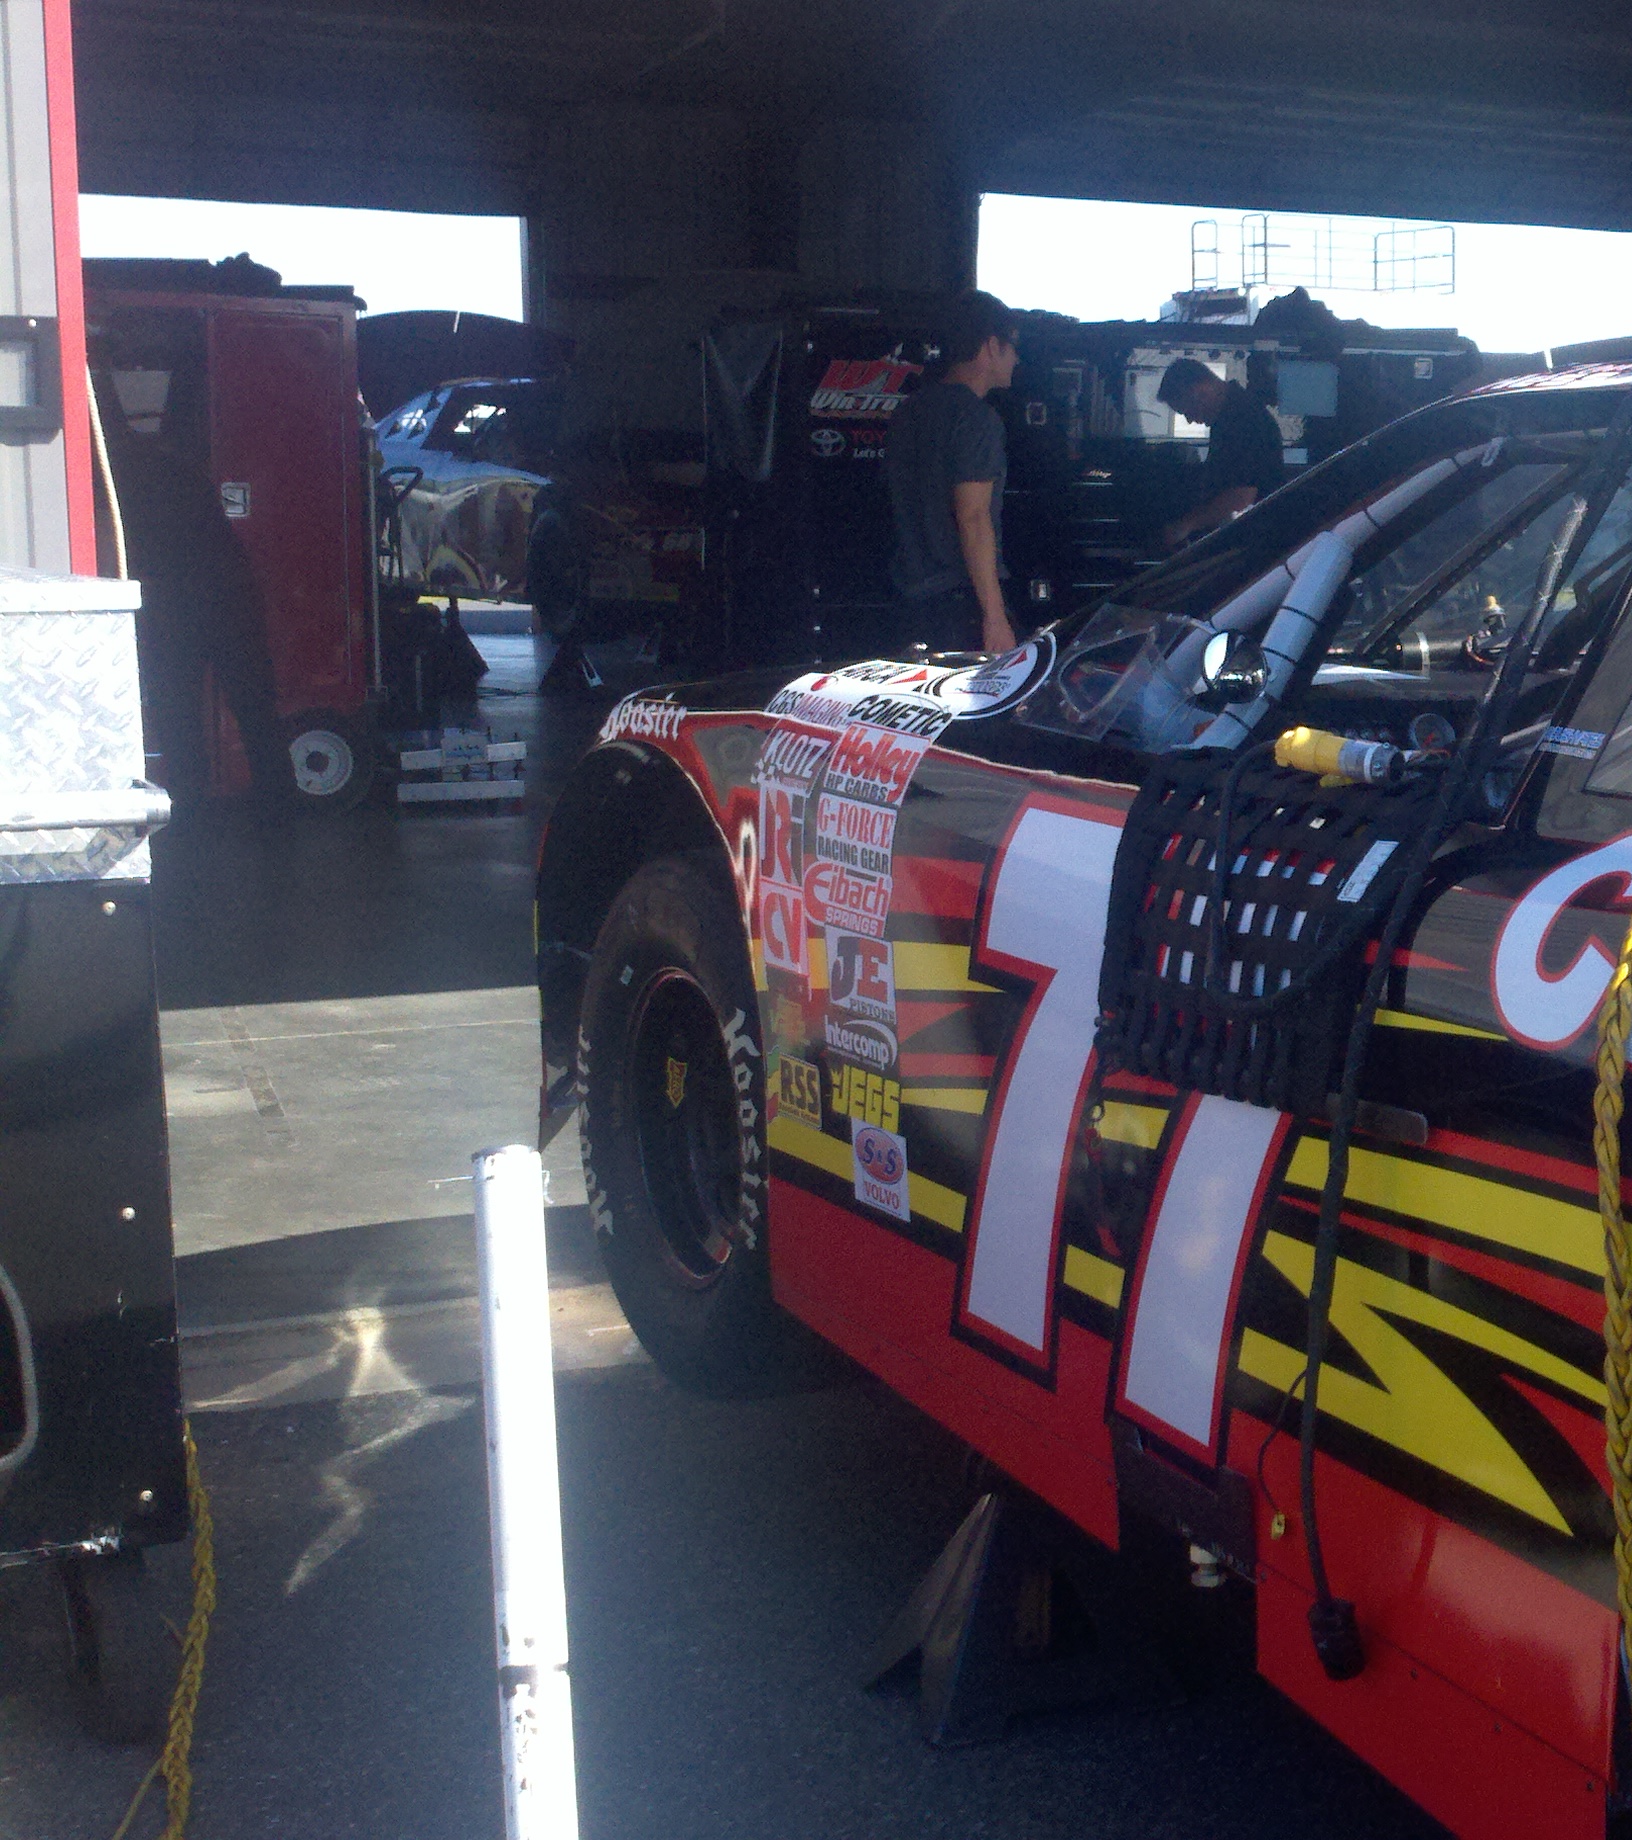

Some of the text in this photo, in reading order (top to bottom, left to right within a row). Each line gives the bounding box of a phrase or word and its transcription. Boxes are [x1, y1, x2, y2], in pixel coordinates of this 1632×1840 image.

[852, 429, 888, 446] TOY
[847, 694, 953, 737] COMETIC
[762, 729, 832, 779] KLOTZ
[829, 724, 921, 803] Holley
[825, 772, 844, 789] HP
[844, 778, 889, 802] CARBS
[817, 797, 895, 850] G-FORCE
[817, 835, 890, 877] RACING GEAR
[804, 862, 890, 929] Eibach
[825, 906, 879, 935] SPRINGS
[830, 935, 889, 1003] JE
[824, 1014, 889, 1070] Intercomp
[831, 1063, 900, 1135] JEGS
[864, 1180, 900, 1209] VOLVO
